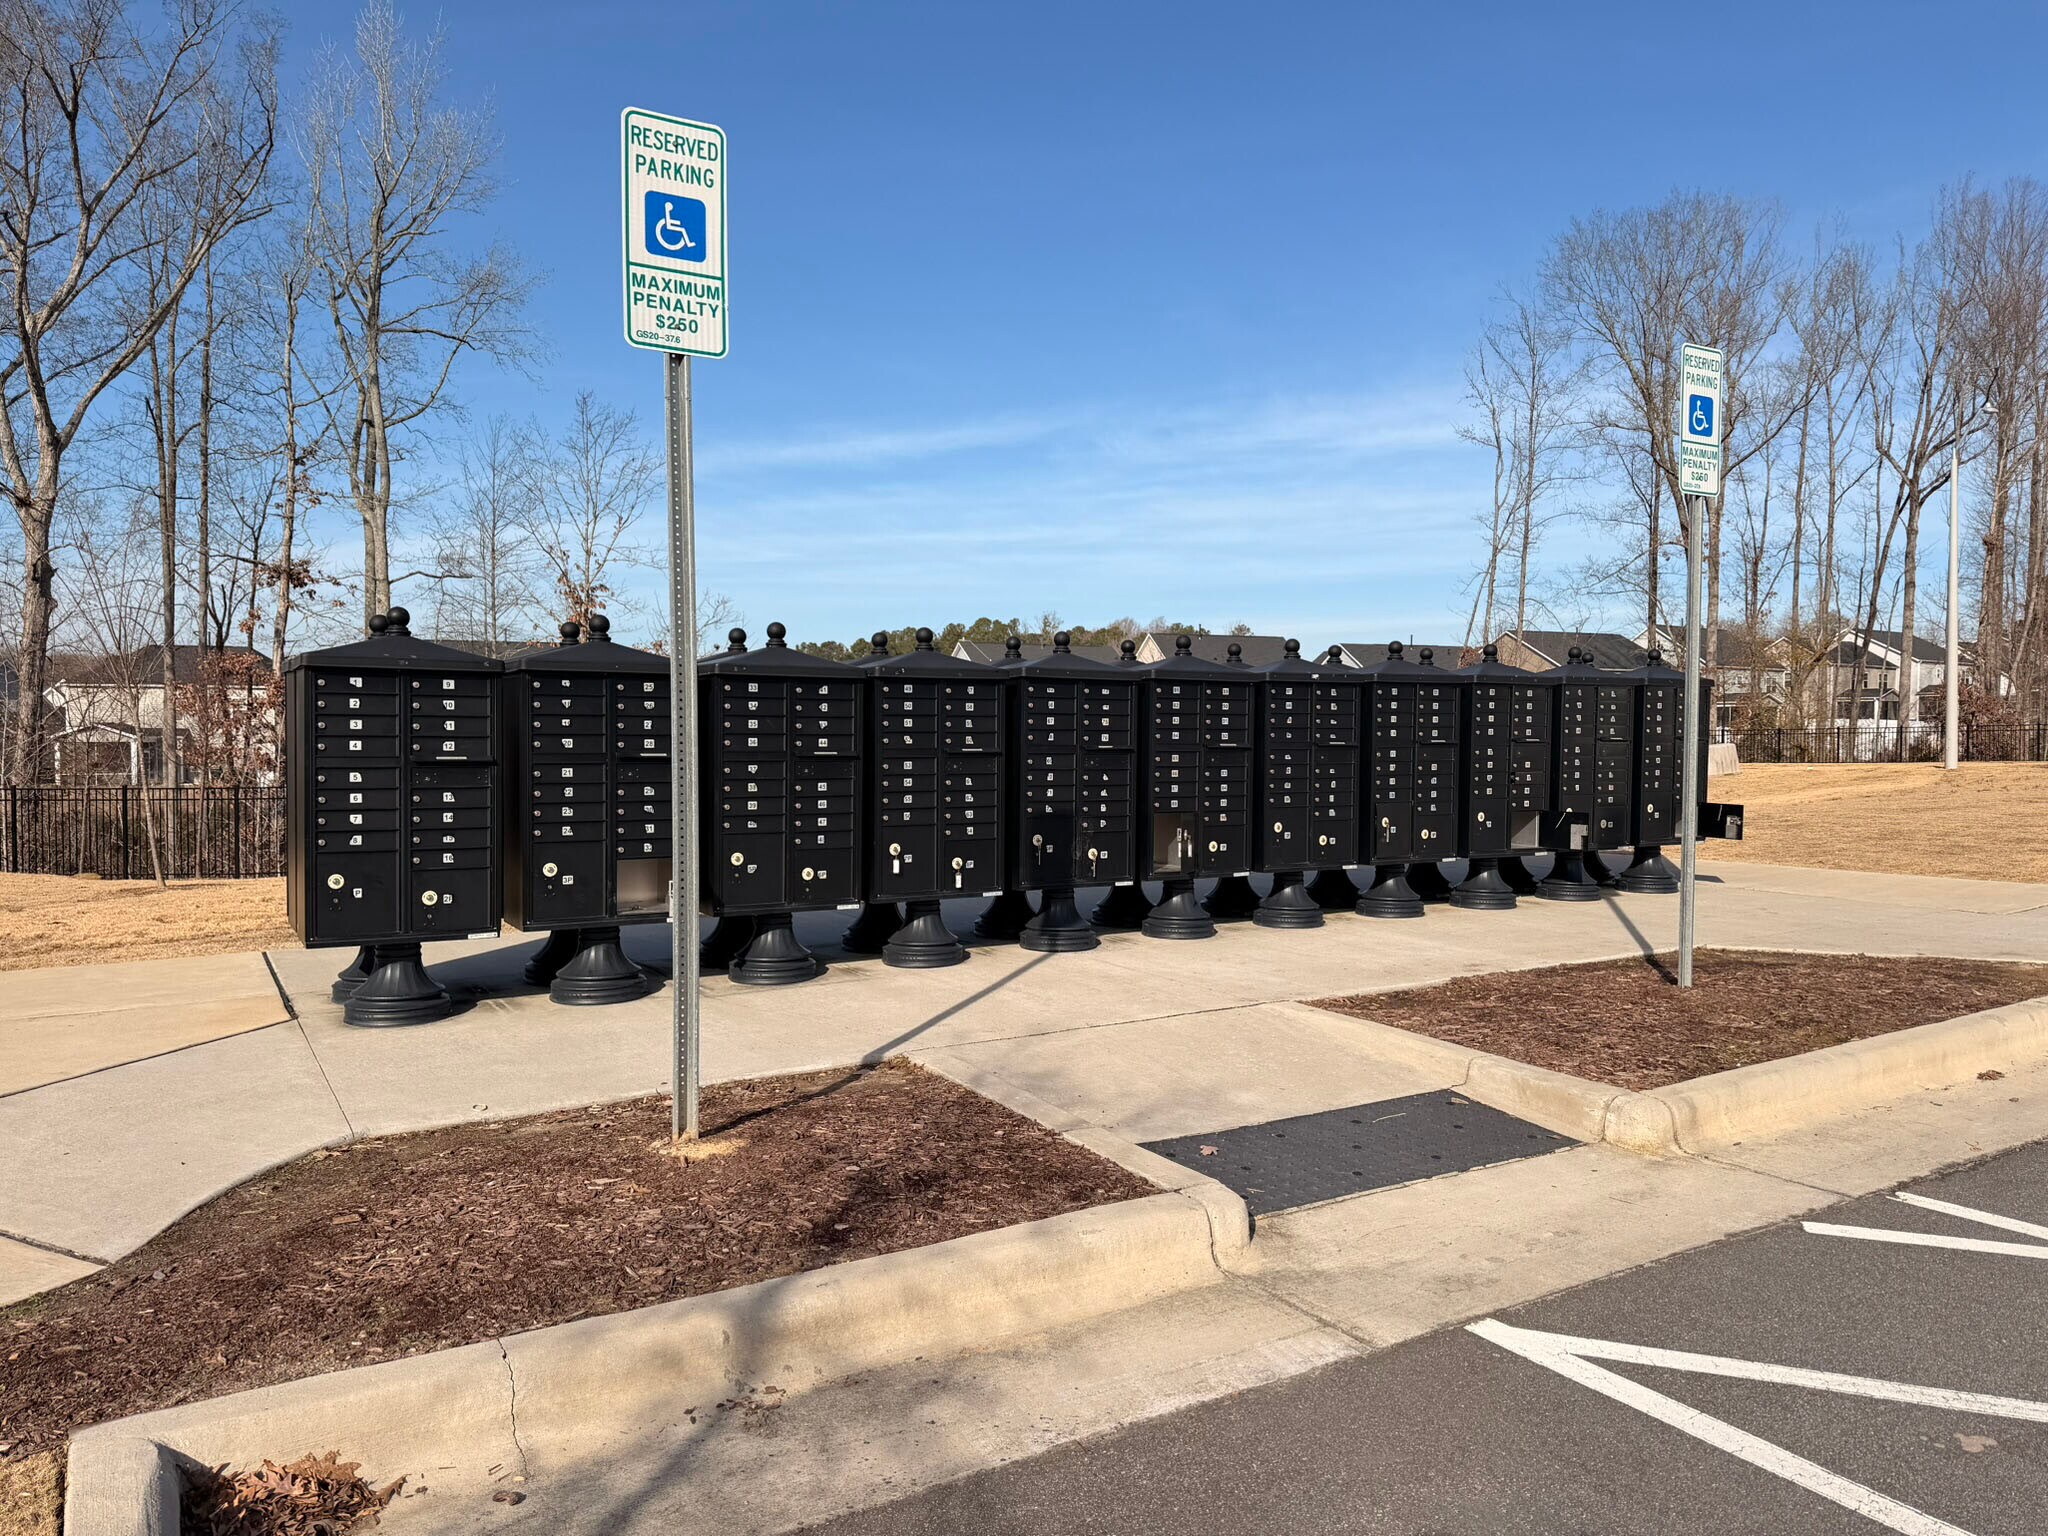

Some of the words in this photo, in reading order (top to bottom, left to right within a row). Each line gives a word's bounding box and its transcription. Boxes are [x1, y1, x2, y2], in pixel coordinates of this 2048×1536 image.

[631, 124, 718, 162] RESERVED
[635, 155, 714, 188] PARKING
[632, 272, 720, 300] MAXIMUM
[634, 292, 719, 318] PENALTY
[656, 313, 698, 334] $250
[1685, 354, 1720, 373] RESERVED
[1686, 372, 1718, 390] PARKING
[1683, 446, 1717, 460] MAXIMUM
[1683, 458, 1716, 471] PENALTY
